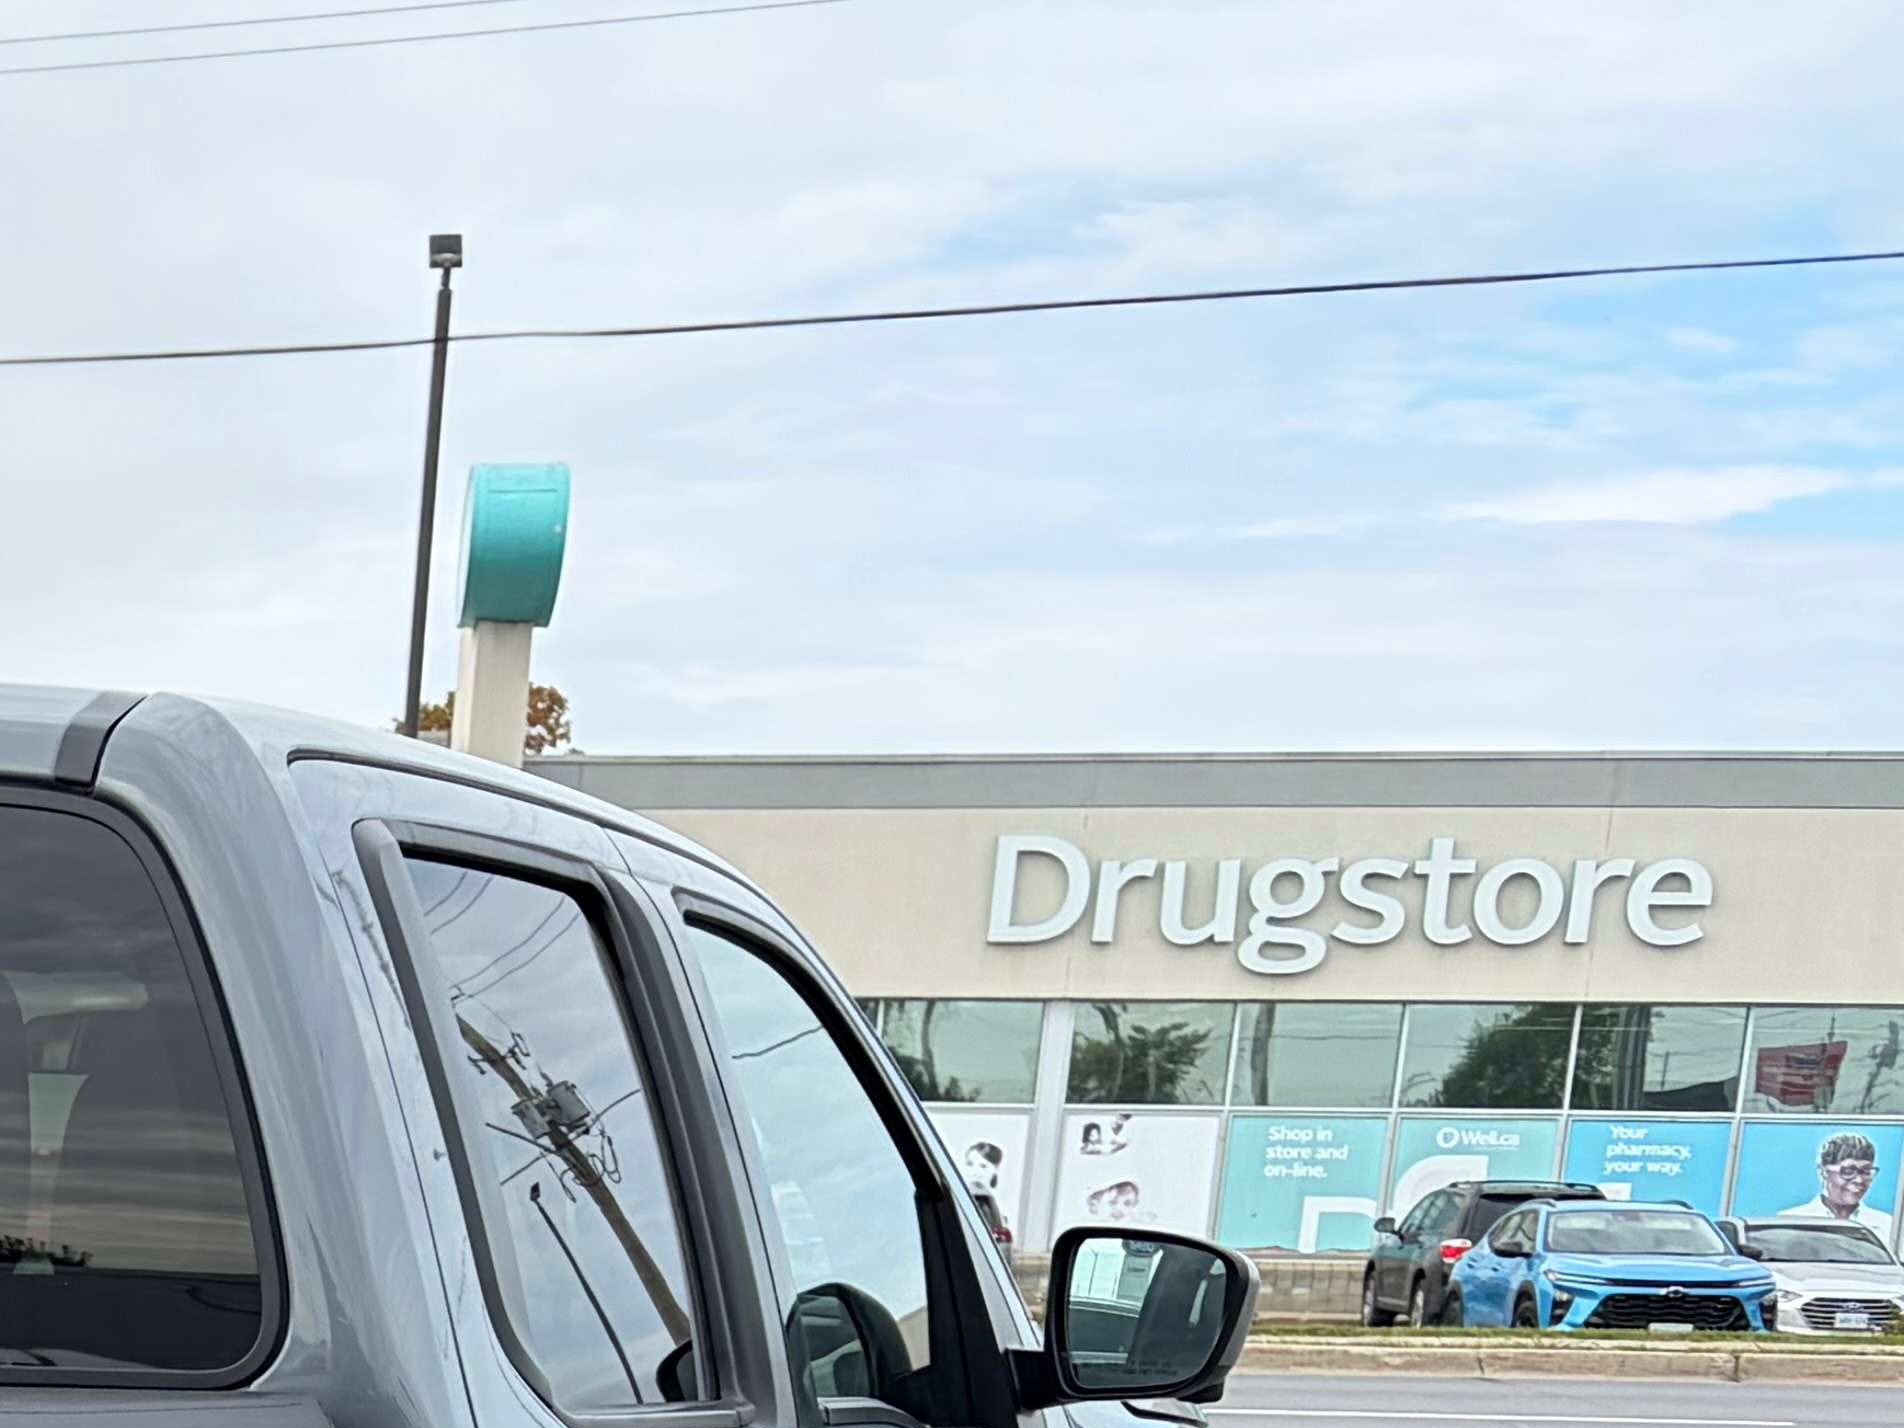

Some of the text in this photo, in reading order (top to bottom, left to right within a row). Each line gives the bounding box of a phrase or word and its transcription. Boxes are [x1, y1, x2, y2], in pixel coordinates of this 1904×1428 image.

[987, 835, 1714, 975] Drugstore
[1268, 1125, 1332, 1143] Shop in
[1610, 1125, 1649, 1139] Your
[1265, 1145, 1349, 1160] store and
[1603, 1161, 1645, 1175] your
